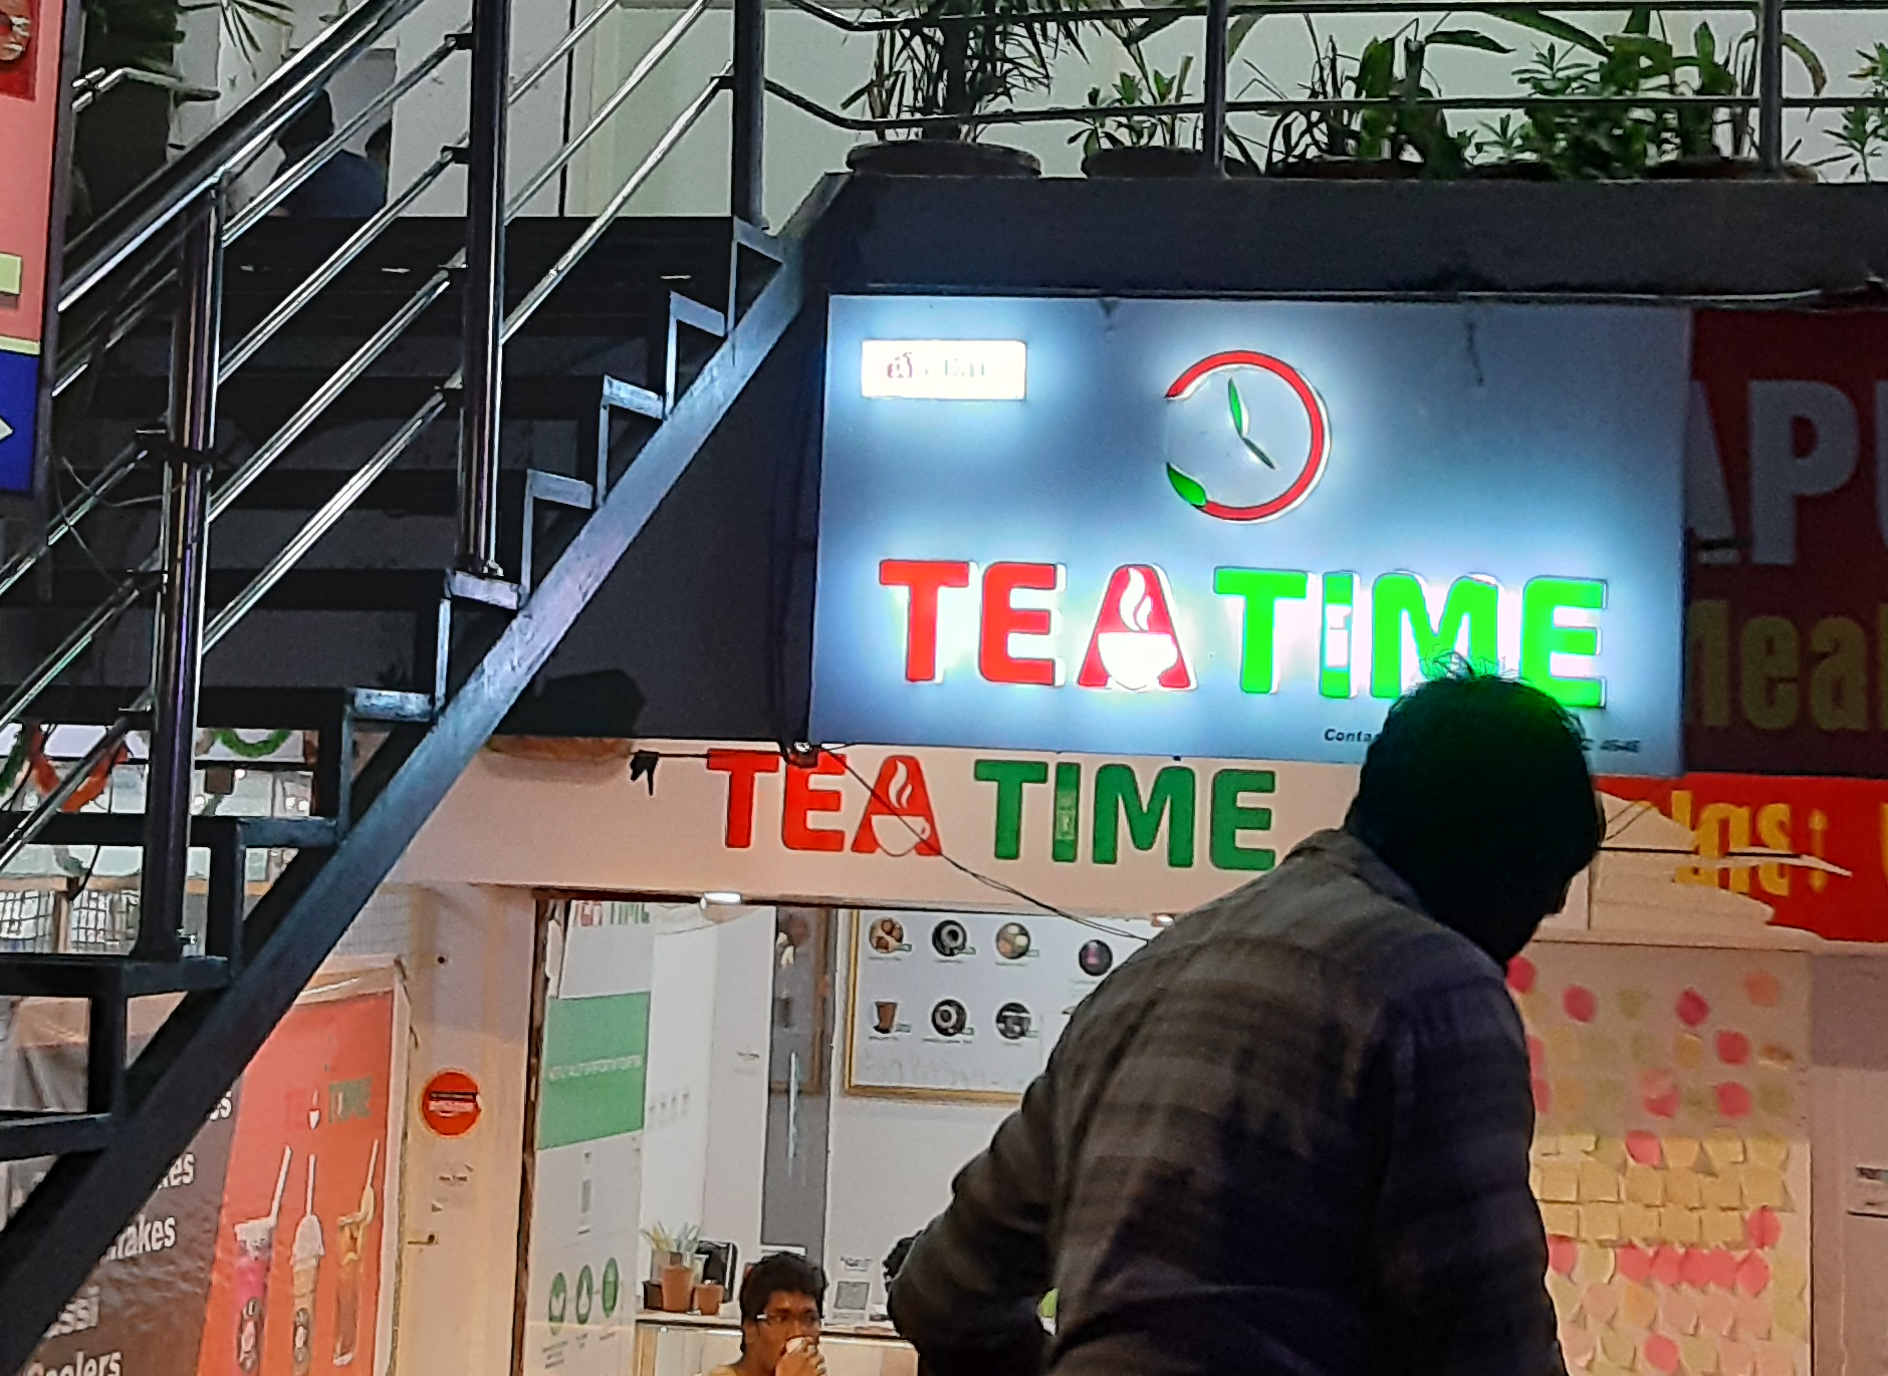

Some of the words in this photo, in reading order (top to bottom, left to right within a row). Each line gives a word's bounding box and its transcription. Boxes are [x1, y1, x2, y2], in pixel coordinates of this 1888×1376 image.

[878, 558, 1197, 692] TEA
[1213, 567, 1609, 709] TIME
[707, 750, 943, 858] TEA
[973, 757, 1277, 871] TIME
